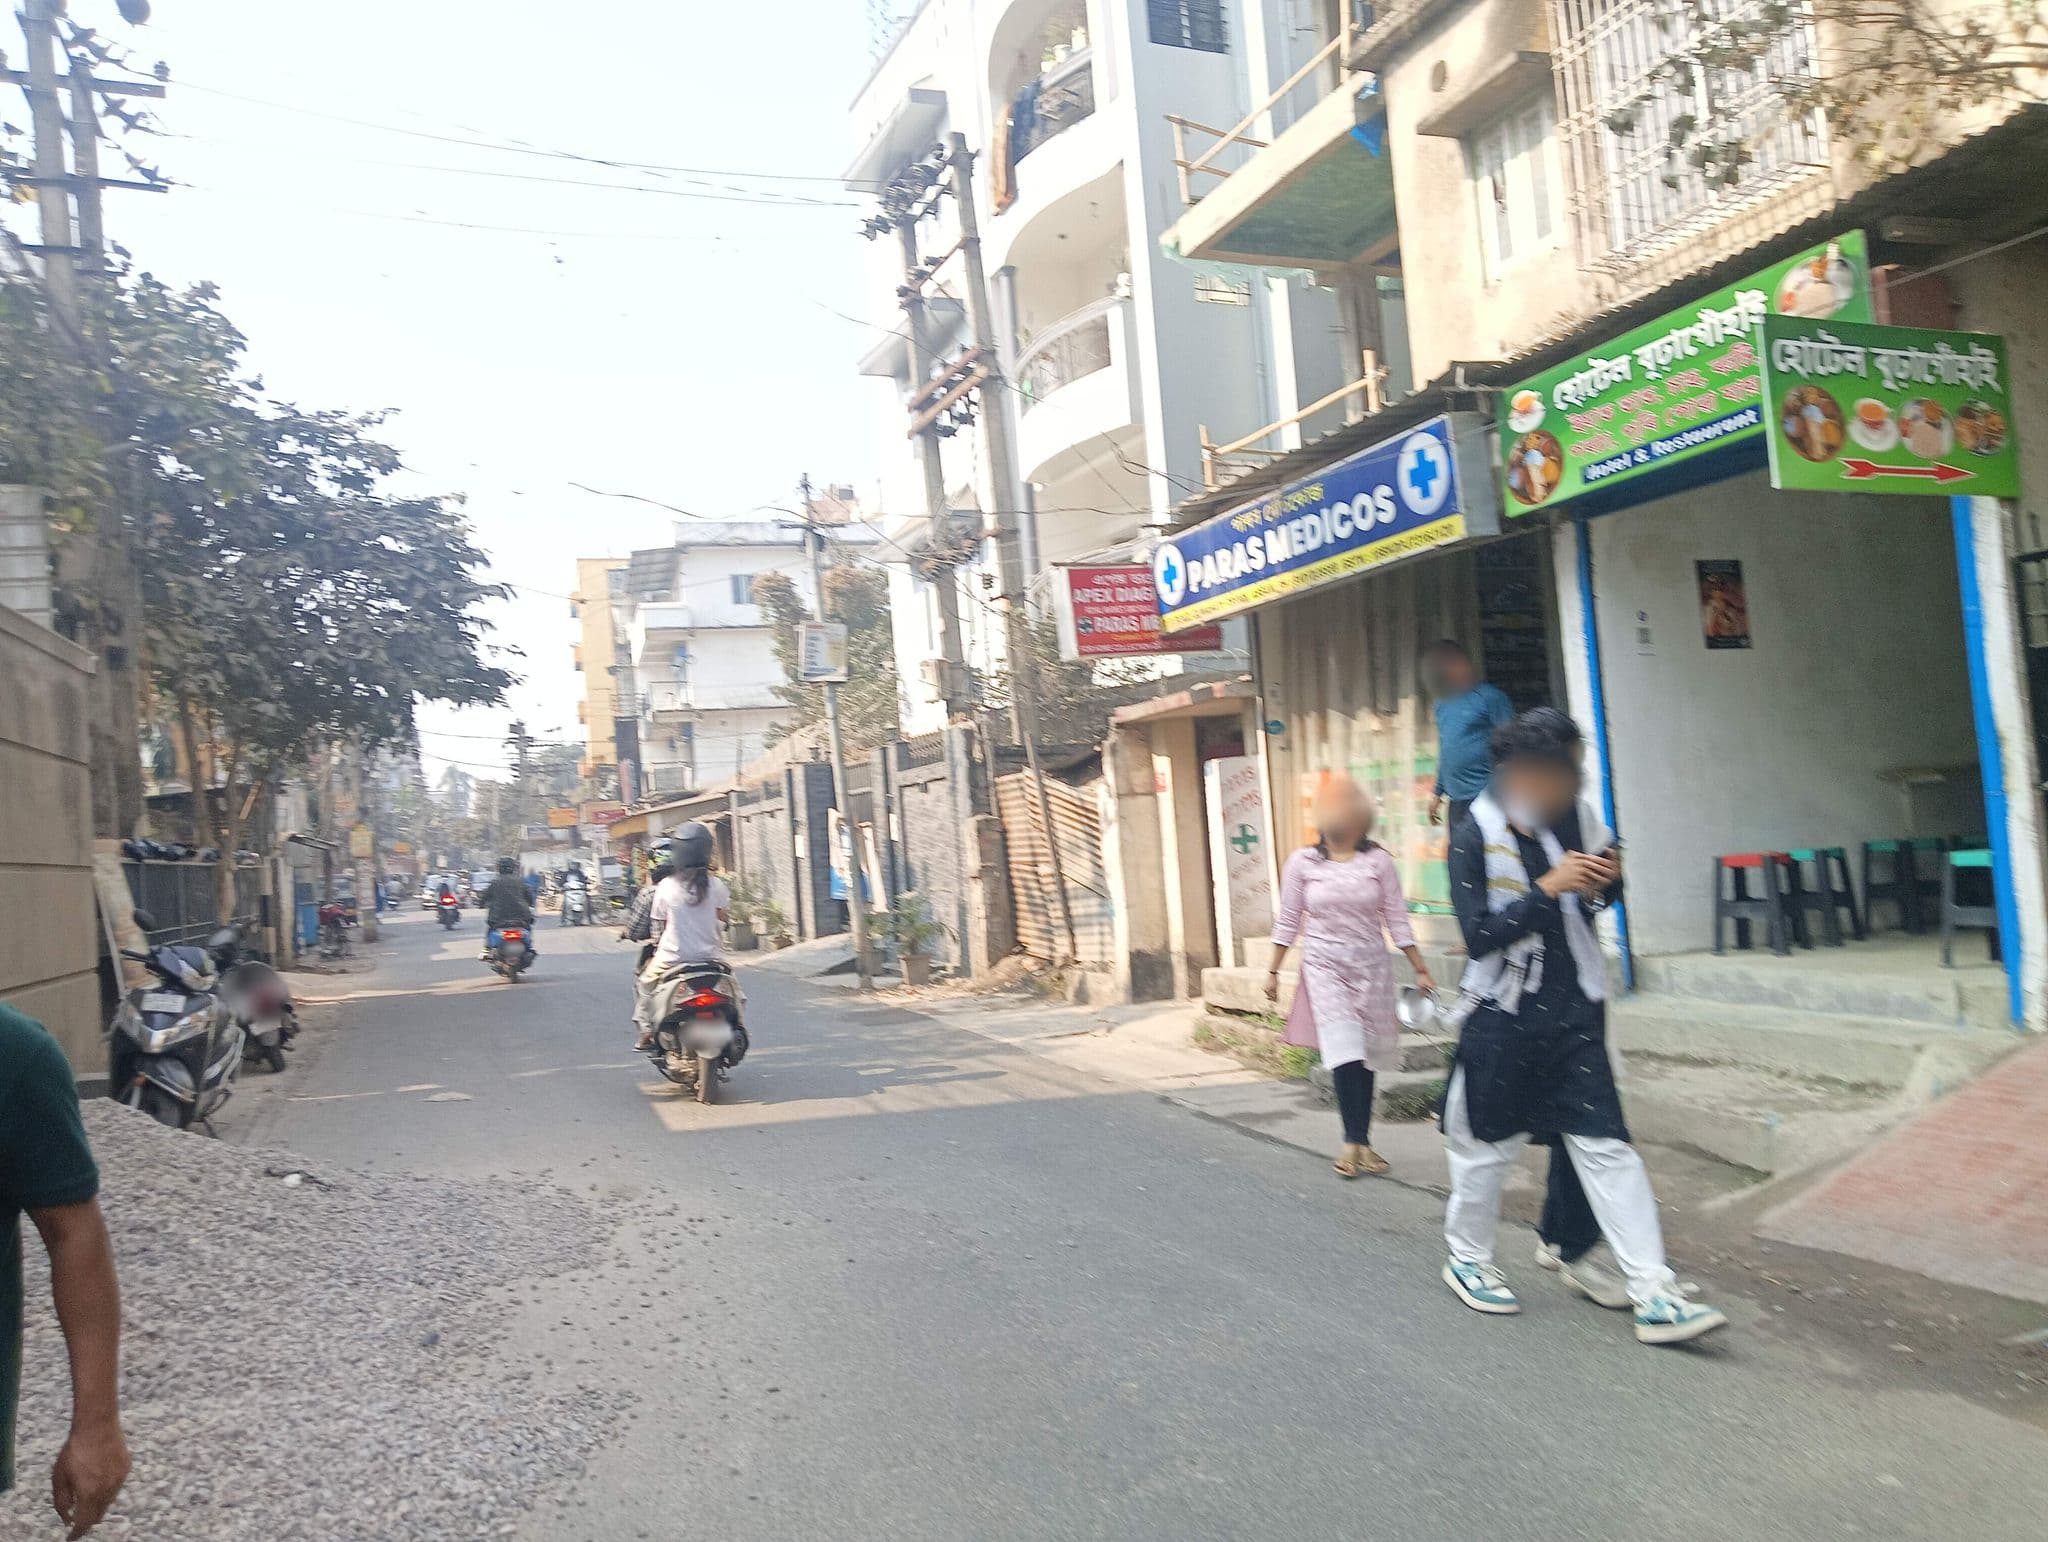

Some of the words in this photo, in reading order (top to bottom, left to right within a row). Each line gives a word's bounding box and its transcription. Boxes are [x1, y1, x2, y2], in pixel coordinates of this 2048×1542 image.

[1771, 328, 1867, 379] হোটেল
[1553, 355, 1632, 410] হোটেল
[1584, 453, 1632, 481] Hotel
[1633, 448, 1650, 463] &
[1650, 409, 1759, 456] Restaurant
[1186, 536, 1265, 593] PARAS
[1264, 484, 1397, 565] MEDICOS
[1072, 588, 1114, 603] APEX
[1094, 616, 1139, 632] PARAS
